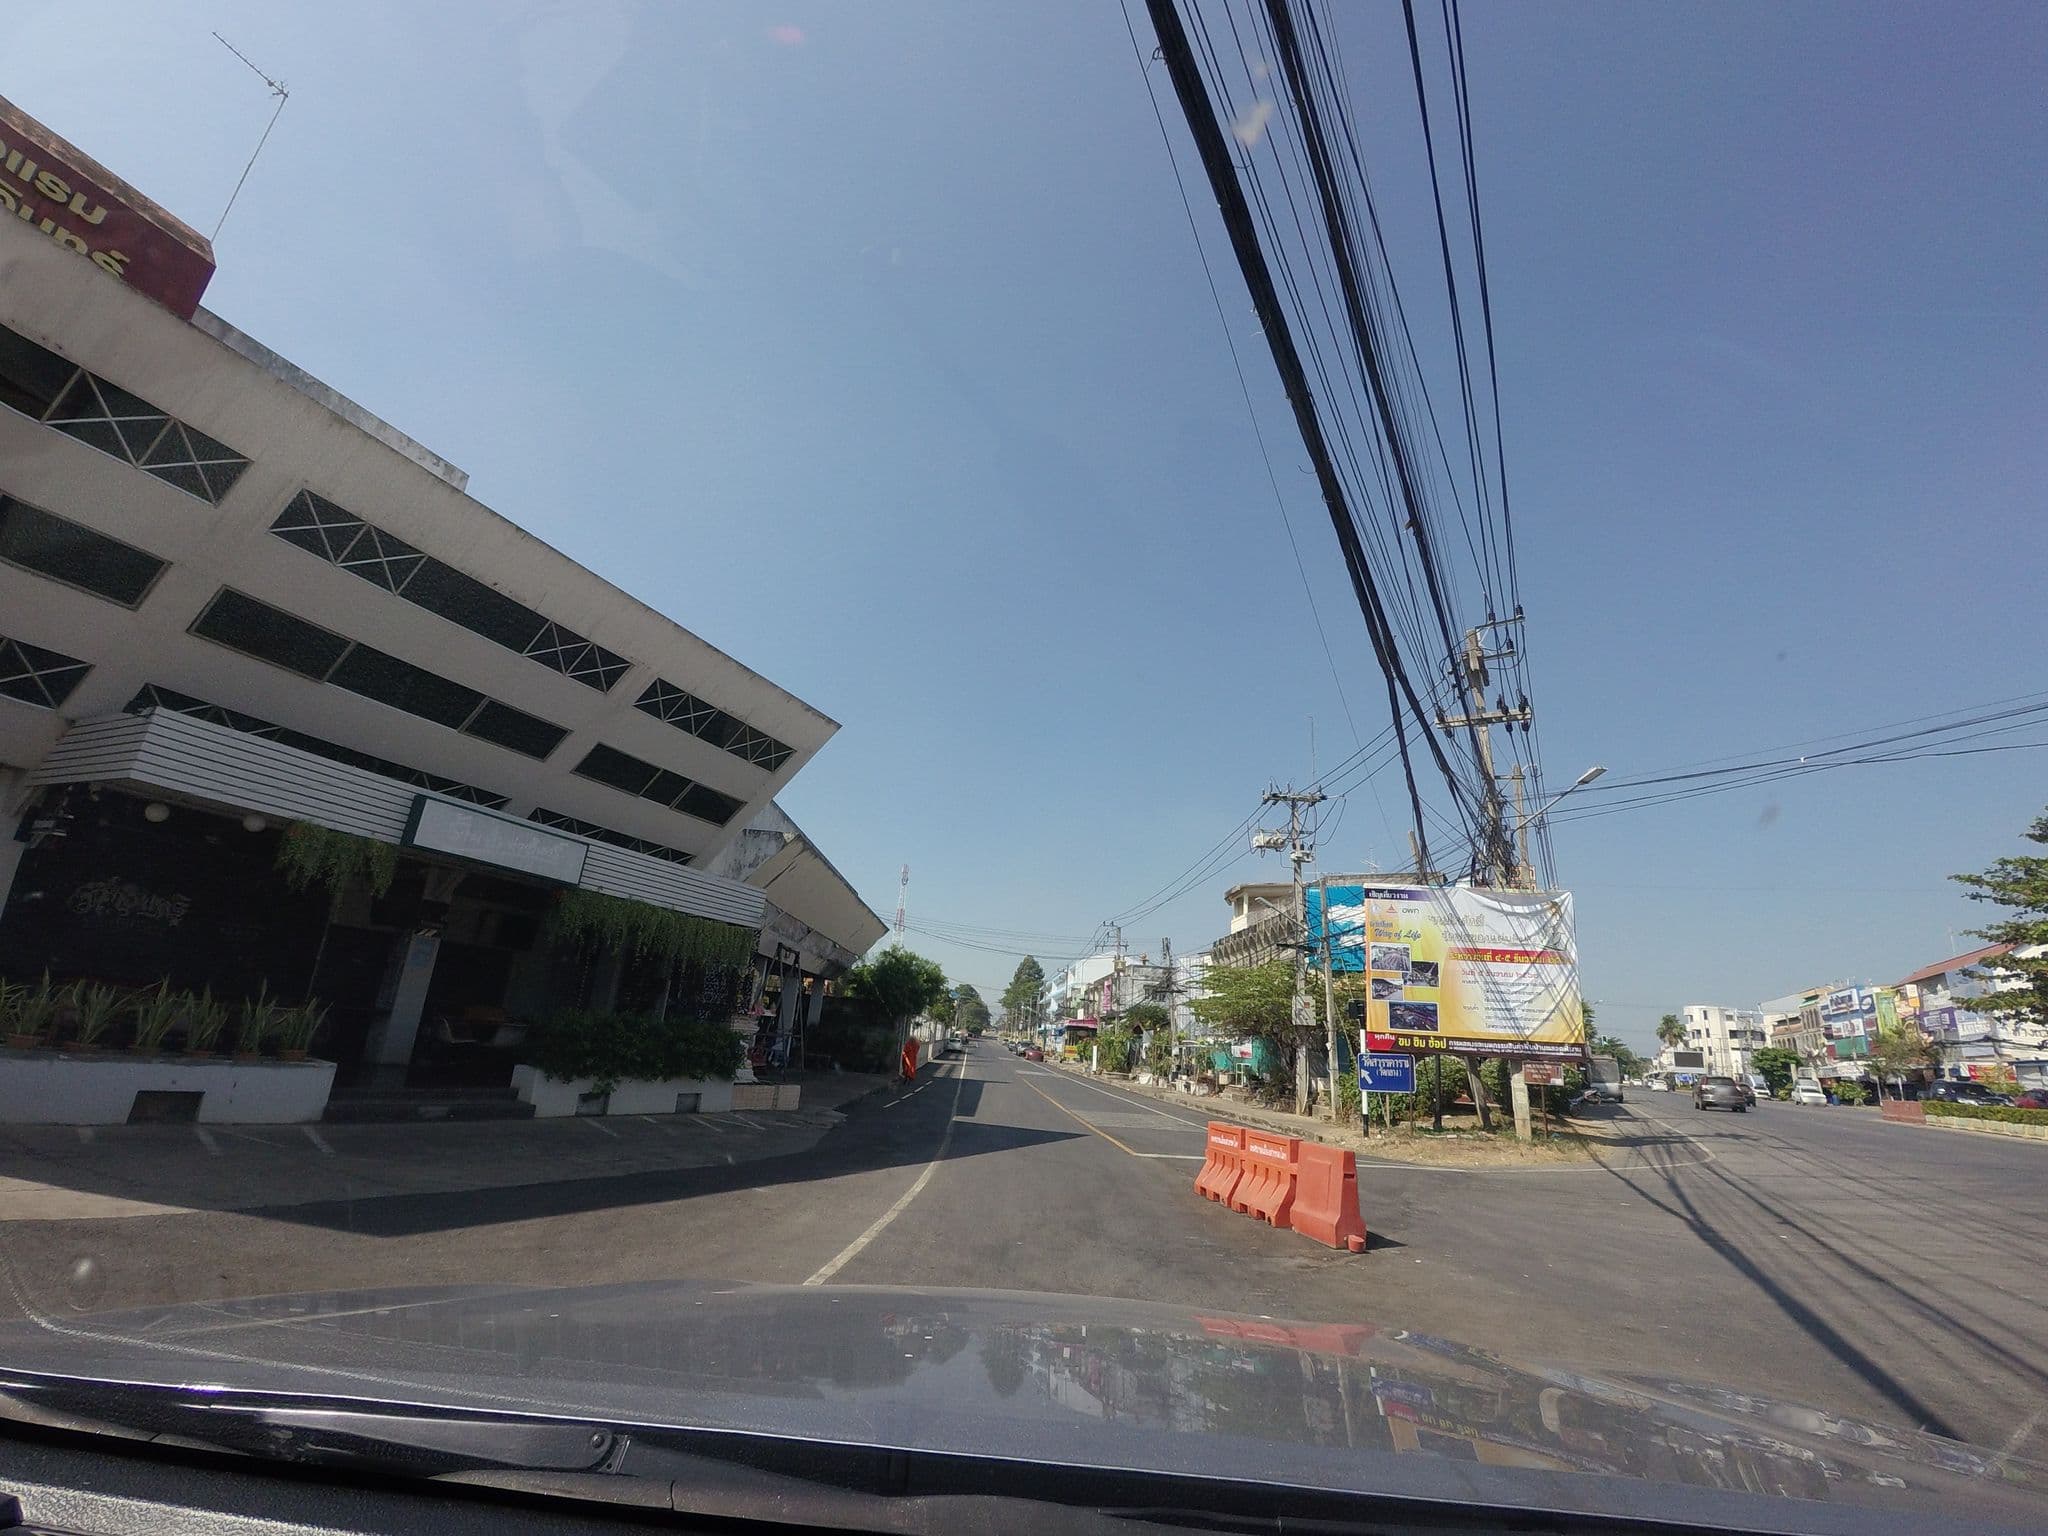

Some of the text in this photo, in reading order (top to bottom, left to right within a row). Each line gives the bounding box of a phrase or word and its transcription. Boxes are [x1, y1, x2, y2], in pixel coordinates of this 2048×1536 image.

[0, 139, 108, 225] แรม
[1374, 928, 1422, 941] Way of Life
